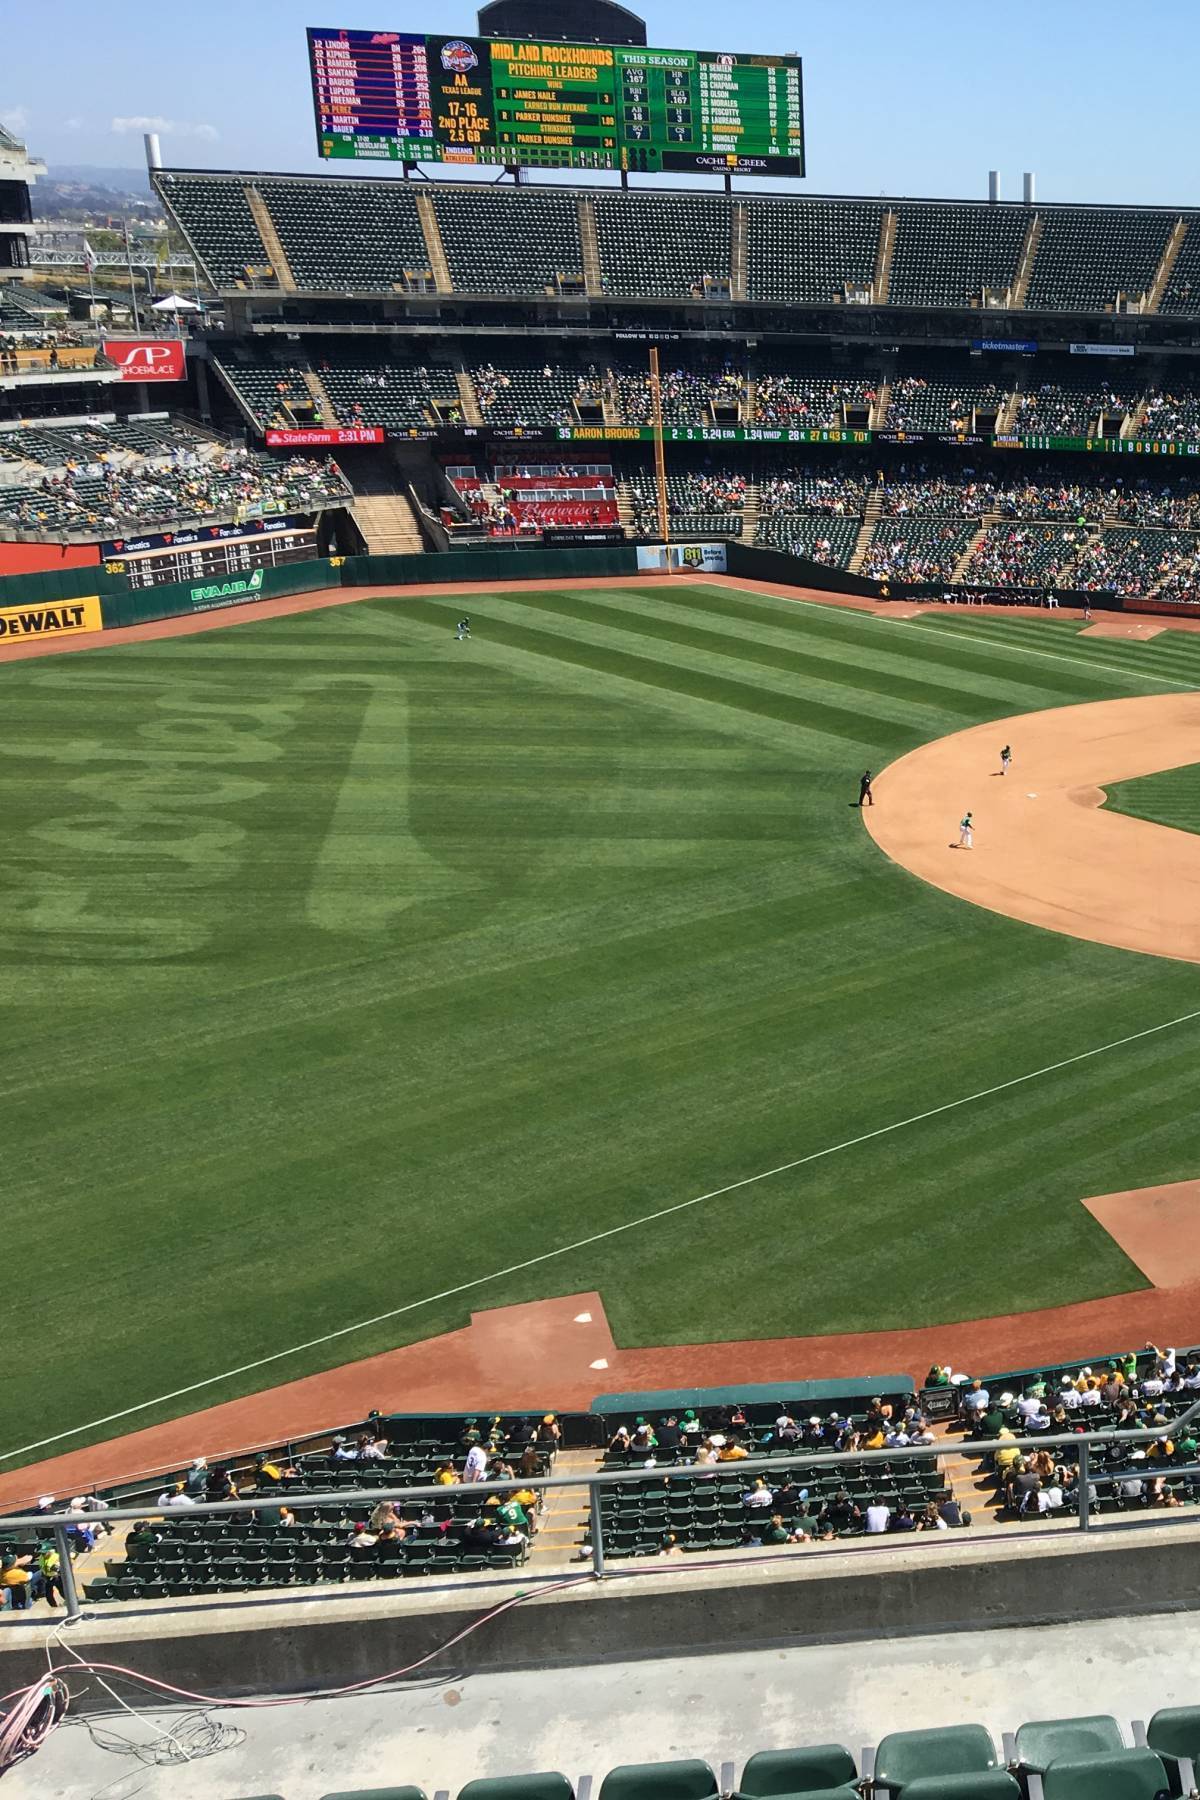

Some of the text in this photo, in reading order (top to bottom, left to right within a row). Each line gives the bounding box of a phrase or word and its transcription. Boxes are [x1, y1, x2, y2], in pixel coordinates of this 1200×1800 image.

[325, 40, 350, 49] LINDOR
[490, 43, 540, 61] MIDLAND
[542, 46, 614, 66] ROCKHOUNDS
[326, 60, 357, 69] RAMIREZ
[622, 54, 688, 66] THIS SEASON
[328, 69, 358, 78] SANTANA
[508, 63, 598, 80] PITCHING LEADERS
[709, 64, 733, 73] SEMIEN
[454, 74, 468, 86] AA
[709, 73, 733, 82] PROFAR
[547, 81, 563, 89] WINS
[709, 82, 739, 90] CHAPMAN
[441, 86, 482, 96] TEXAS LEAGUE
[514, 90, 537, 100] JAMES
[629, 87, 642, 95] RBI
[710, 90, 729, 99] OLSON
[331, 96, 361, 105] FREEMAN
[633, 94, 640, 102] 3
[524, 102, 588, 112] EARNED RUN AVERAGE
[710, 99, 738, 108] MORALES
[448, 102, 477, 117] 17-16
[711, 108, 740, 117] PISCOTTY
[332, 116, 360, 125] MARTIN
[515, 111, 572, 123] PARKER DUNSHEE
[711, 116, 741, 126] LAUREANO
[459, 117, 490, 130] PLACE
[332, 125, 410, 136] BAUER ERA
[540, 125, 576, 134] STRIKEOUTS
[449, 130, 481, 142] 2.5 GB
[517, 134, 613, 147] PARKER DUNSHEE 34
[712, 132, 738, 141] HUNDLEY
[445, 146, 473, 154] INDIANS
[712, 144, 780, 154] BROOKS ERA
[696, 157, 767, 168] CACHE CREEK
[982, 341, 1026, 351] ticketmaster
[338, 430, 358, 442] 2:31
[360, 430, 376, 441] PM
[559, 428, 864, 441] 35 AARON BROOKS 5.24 ERA 1.34 WHIP 28 27 43 70
[1187, 443, 1200, 454] CLE
[517, 502, 600, 518] Budweise
[263, 521, 286, 530] Fanatics
[174, 534, 198, 544] Fanatics
[684, 547, 703, 560] 811
[105, 562, 126, 574] 362
[190, 580, 247, 601] EVA AIR
[1064, 1399, 1074, 1408] 24
[508, 1509, 517, 1520] 9
